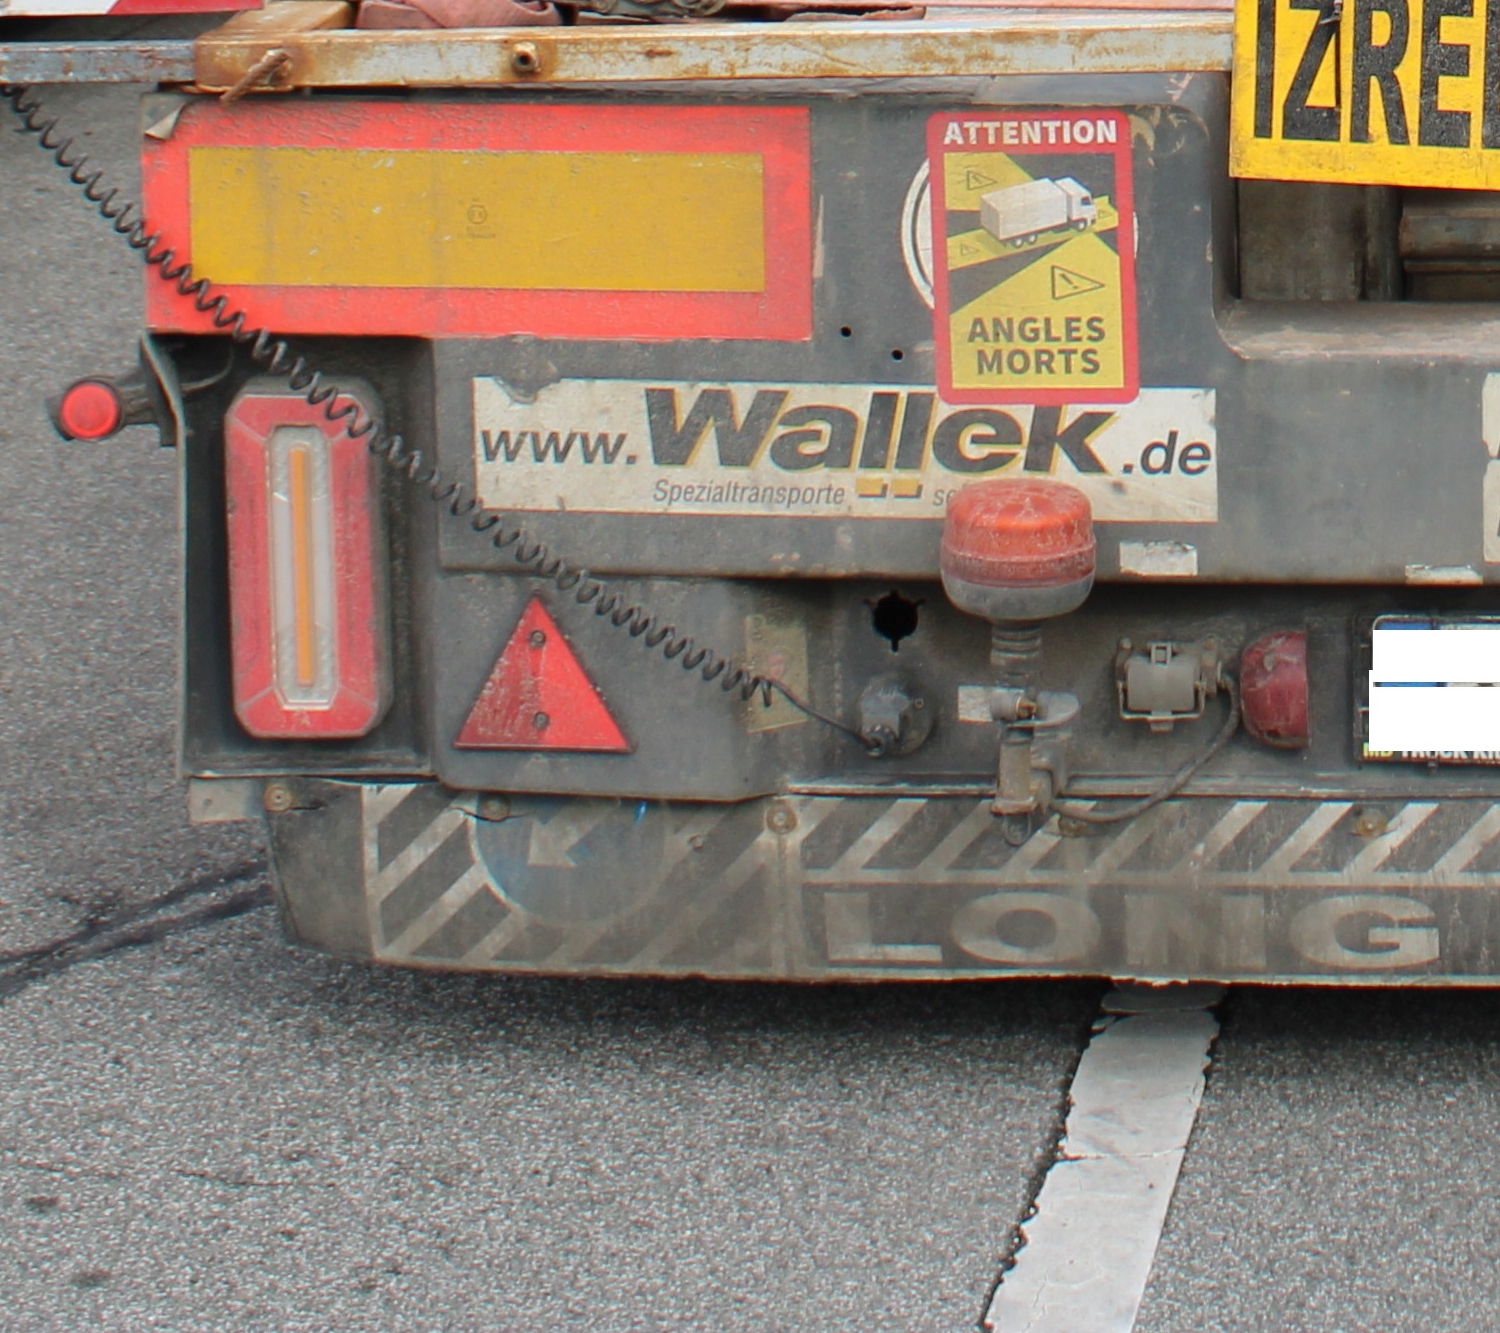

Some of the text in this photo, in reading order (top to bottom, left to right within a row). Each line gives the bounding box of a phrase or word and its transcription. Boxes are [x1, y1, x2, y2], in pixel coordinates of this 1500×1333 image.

[942, 119, 1118, 146] ATTENTION
[967, 315, 1106, 344] ANGLES
[976, 347, 1101, 376] MORTS
[652, 478, 846, 508] Spezialtransporte
[822, 890, 1441, 972] LONG
